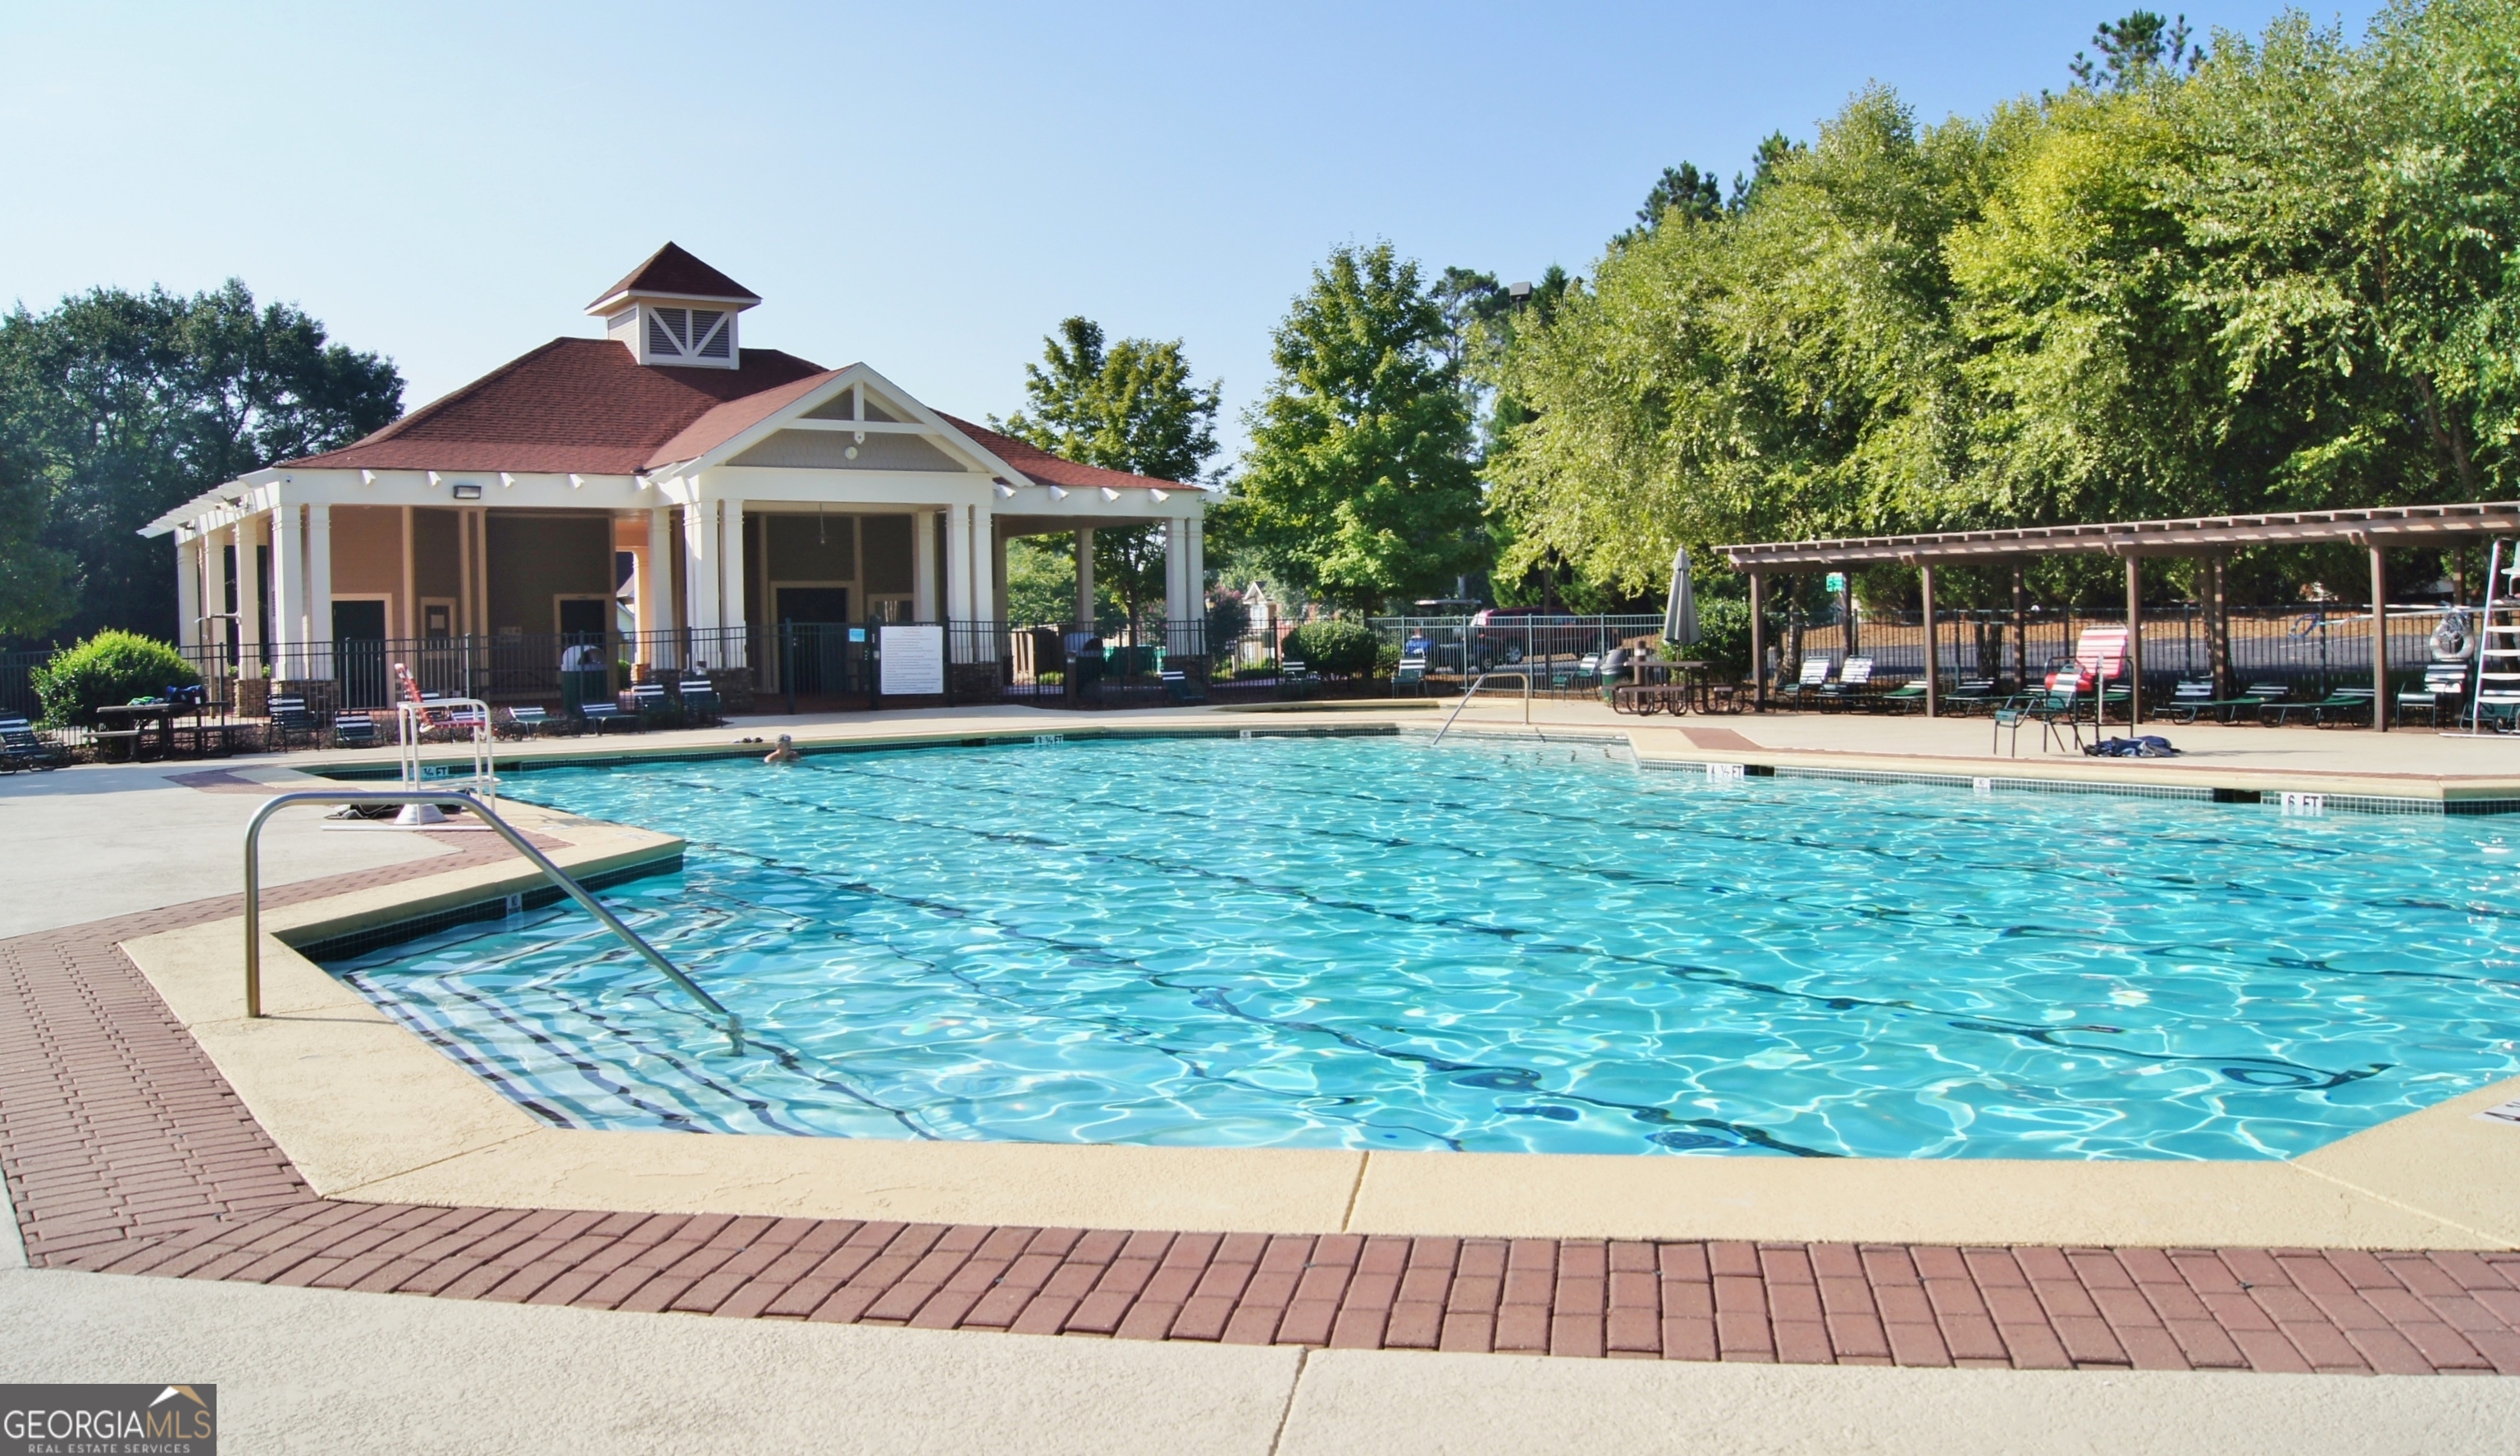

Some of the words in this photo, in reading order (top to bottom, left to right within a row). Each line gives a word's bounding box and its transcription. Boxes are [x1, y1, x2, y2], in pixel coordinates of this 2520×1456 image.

[1054, 735, 1062, 744] FT
[436, 767, 447, 776] FT
[1732, 765, 1742, 778] FT
[2303, 796, 2319, 807] FT
